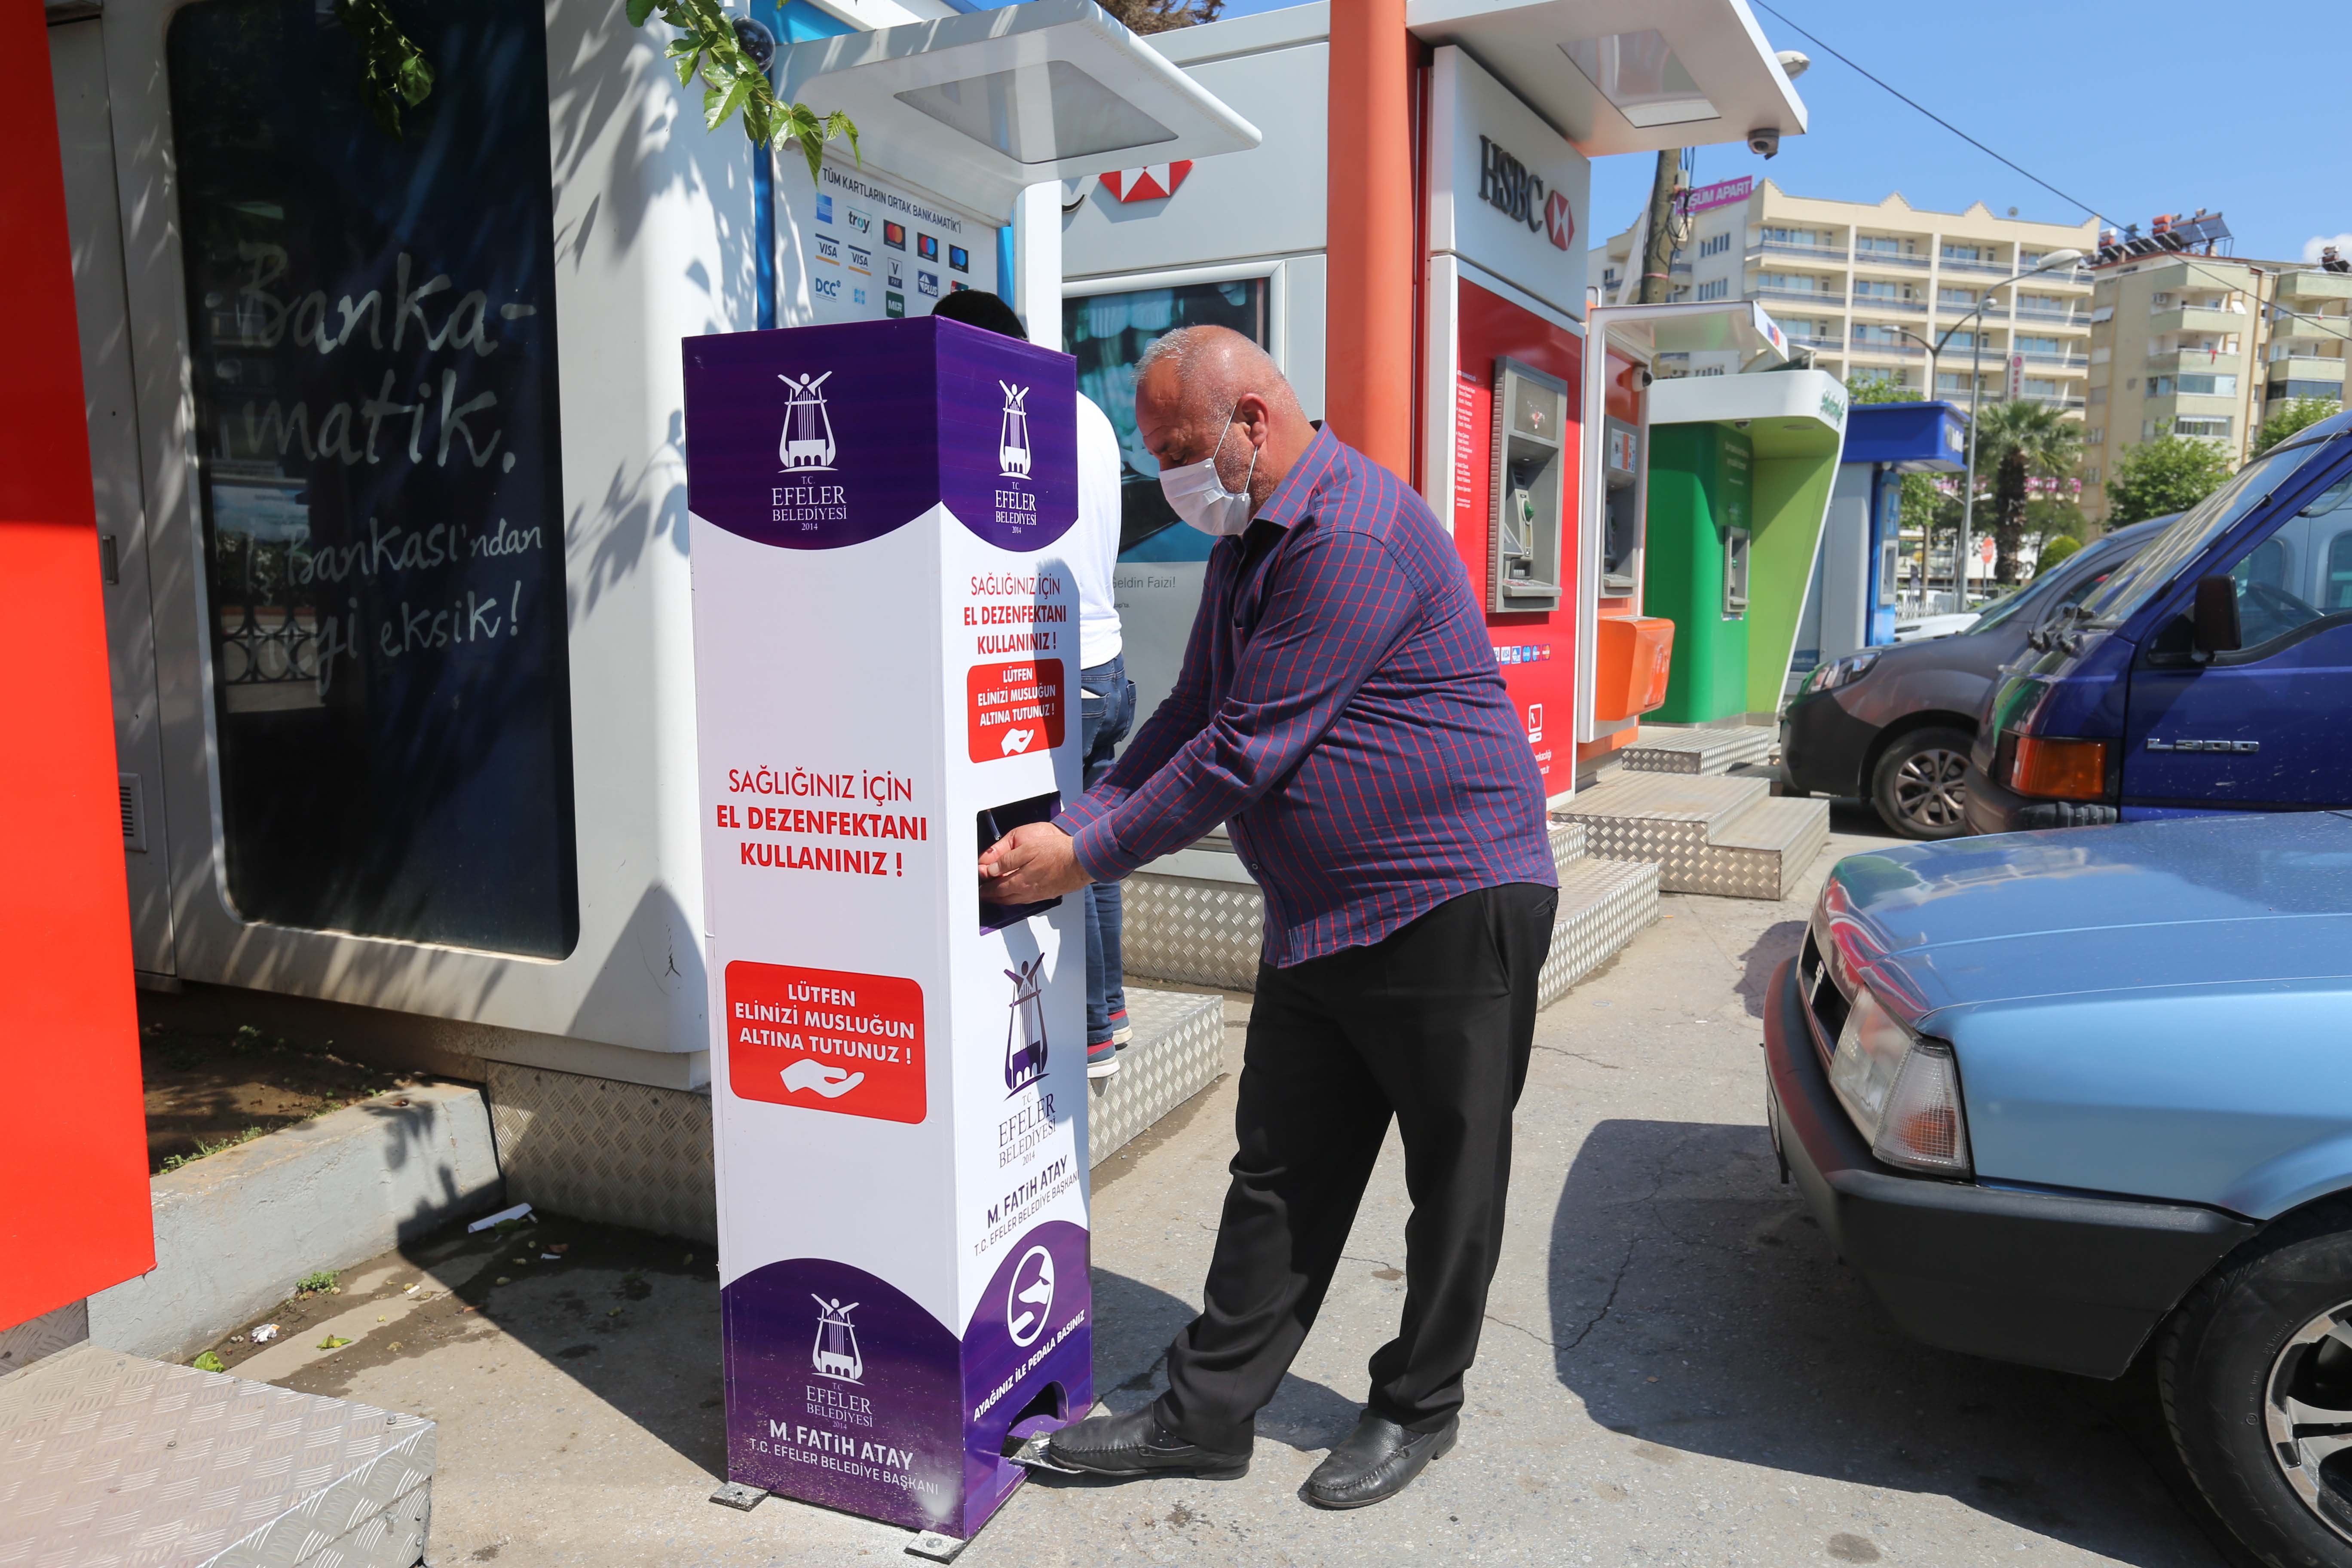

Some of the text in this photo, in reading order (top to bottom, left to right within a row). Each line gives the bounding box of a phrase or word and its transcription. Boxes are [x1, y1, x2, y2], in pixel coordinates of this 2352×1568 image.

[823, 167, 841, 187] TÜM
[843, 176, 886, 204] KARTLARIN
[888, 195, 912, 214] ORTAK
[1478, 135, 1544, 233] HSBC
[1716, 181, 1751, 201] APART
[848, 211, 870, 233] troy
[818, 242, 837, 257] VISA
[851, 252, 868, 266] VISA
[891, 262, 898, 275] V
[816, 277, 836, 297] DCC
[891, 278, 900, 286] PAY
[924, 284, 938, 296] PLUS
[888, 300, 903, 313] MIR
[242, 369, 515, 473] matik.
[801, 476, 815, 484] T.C.
[772, 486, 847, 506] EFELER
[995, 490, 1036, 511] EFELER
[772, 506, 847, 521] BELEDİYESİ
[995, 511, 1037, 526] BELEDİYESİ
[971, 573, 1060, 599] SAĞLIĞINIZ İÇİN
[1148, 576, 1176, 588] Faizi!
[380, 580, 519, 657] eksik!
[964, 605, 1066, 626] EL DEZENFEKTANI
[977, 632, 1056, 654] KULLANINIZ !
[1003, 667, 1032, 683] LÜTFEN
[977, 682, 1055, 706] ELİNİZİ MUSLUĞUN
[980, 708, 1011, 726] ALTINA
[1012, 704, 1050, 722] TUTUNUZ
[729, 765, 912, 806] SAĞLIĞINIZ İÇİN
[717, 805, 927, 841] EL DEZENFEKTANI
[741, 842, 902, 877] KULLANINIZ !
[788, 980, 856, 1007] LÜTFEN
[735, 1000, 915, 1039] ELİNİZİ MUSLUĞUN
[739, 1027, 912, 1065] ALTINA TUTUNUZ !
[1022, 1092, 1033, 1106] T.C.
[998, 1093, 1056, 1148] EFELER
[999, 1115, 1056, 1169] BELEDİYESİ
[1023, 1151, 1035, 1166] 2014
[988, 1155, 1068, 1228] M. FATİH ATAY
[974, 1170, 1080, 1256] T.C. EFELER BELEDİYE BAŞKANI
[974, 1309, 1085, 1422] AYAĞINIZ İLE PEDALA BASINIZ
[806, 1385, 872, 1414] EFELER
[806, 1402, 873, 1427] BELEDİYESİ
[833, 1421, 847, 1430] 2014
[770, 1420, 913, 1470] M. FATİH ATAY
[750, 1439, 938, 1495] T.C. EFELER BELEDİYE BAŞKANI
